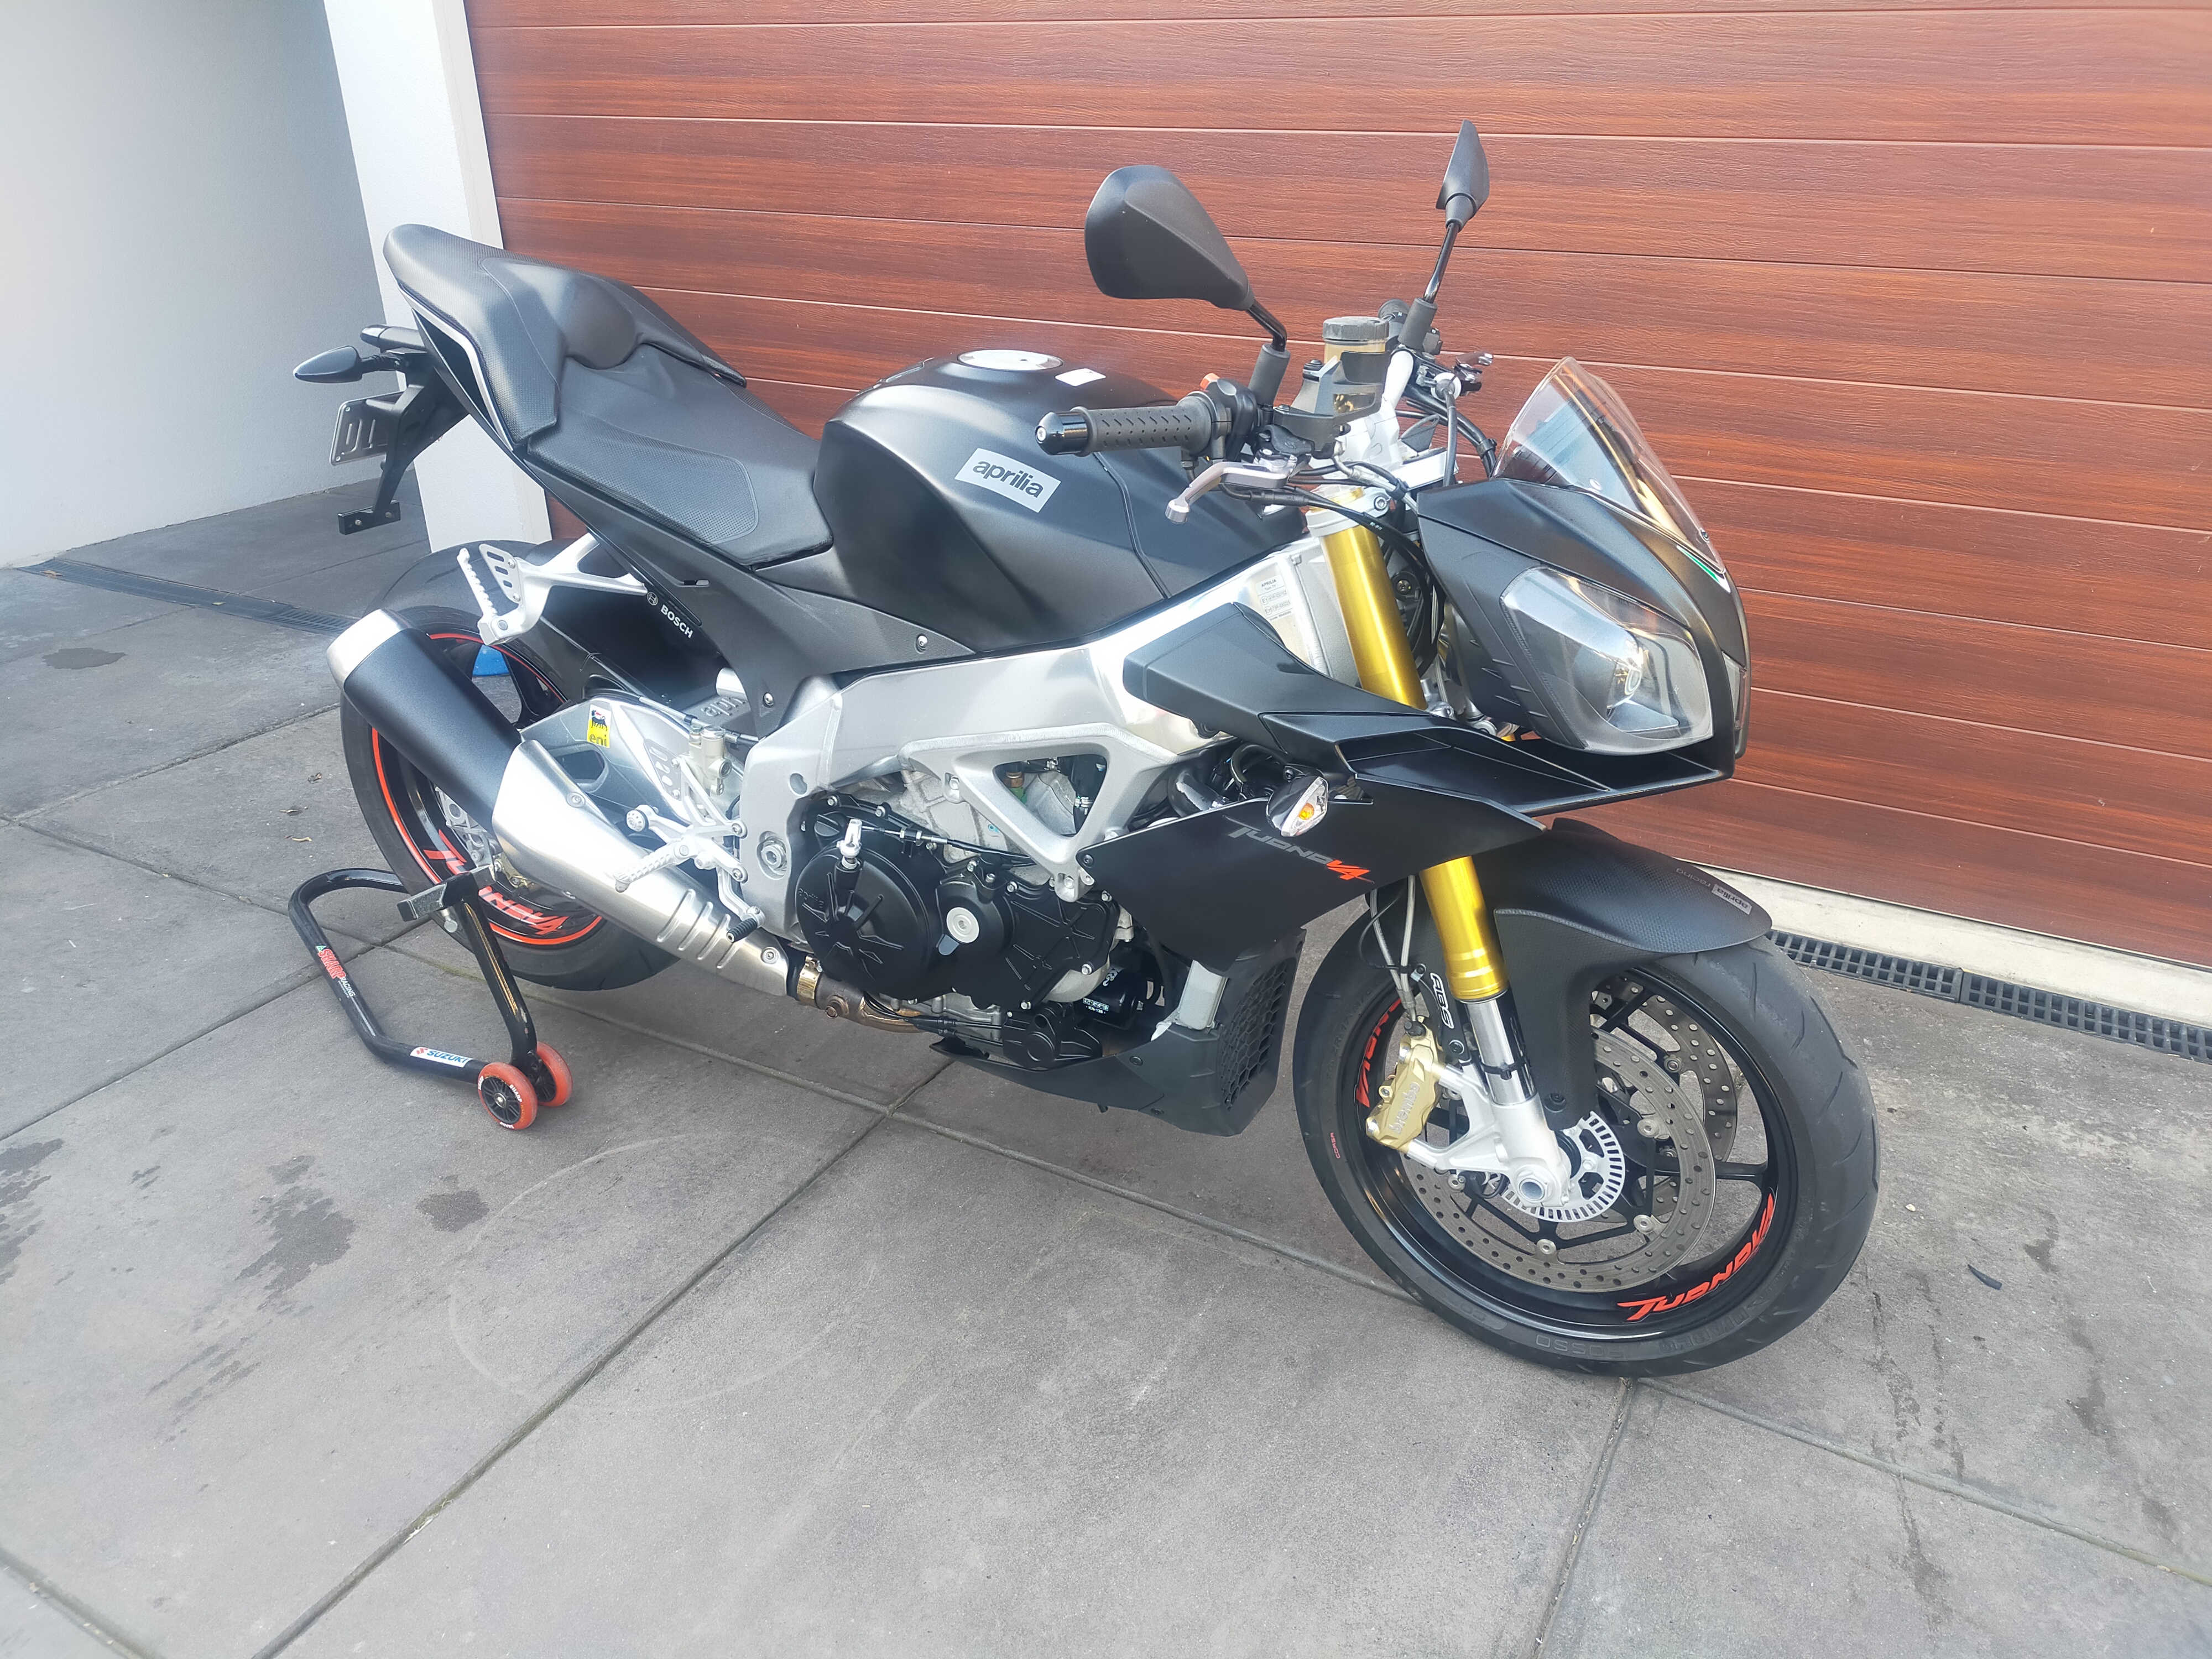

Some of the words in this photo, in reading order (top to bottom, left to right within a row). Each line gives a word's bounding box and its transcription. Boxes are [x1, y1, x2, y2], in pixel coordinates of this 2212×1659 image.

[973, 461, 1044, 498] aprilia
[1261, 578, 1276, 587] APRILIA
[660, 604, 693, 639] BOSCH
[589, 734, 607, 747] eni
[1676, 868, 1711, 888] racing
[1717, 887, 1749, 909] aprilia
[318, 948, 347, 979] SHARP
[339, 977, 356, 998] RACING
[1430, 972, 1454, 1029] ABS
[426, 1050, 469, 1063] SUZUKI
[1388, 1081, 1421, 1135] brembo
[1330, 1132, 1341, 1159] CORSA
